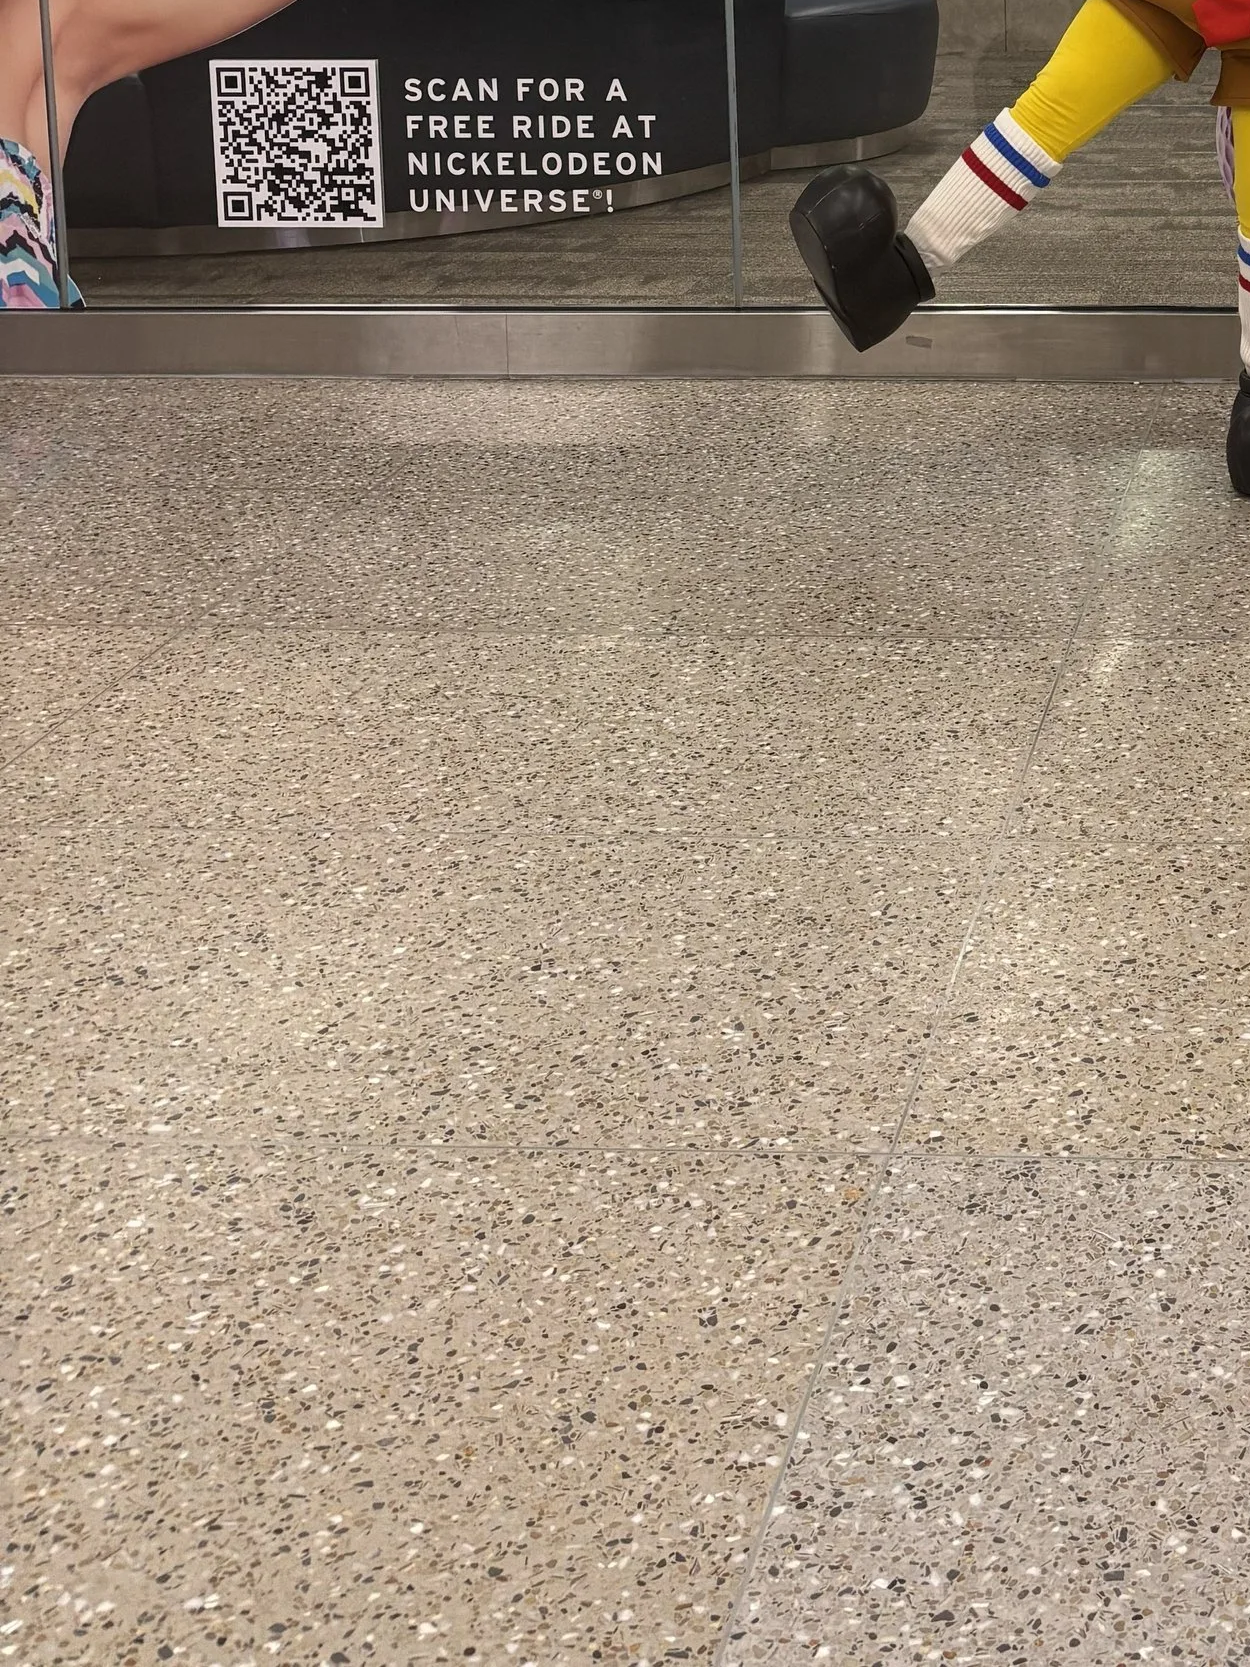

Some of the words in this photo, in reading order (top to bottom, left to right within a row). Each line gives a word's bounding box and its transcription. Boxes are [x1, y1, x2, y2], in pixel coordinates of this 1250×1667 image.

[404, 77, 498, 102] SCAN
[517, 77, 586, 102] FOR
[606, 78, 628, 102] A
[406, 115, 496, 139] FREE
[513, 114, 596, 139] RIDE
[612, 114, 656, 139] AT
[408, 151, 664, 176] NICKELODEON
